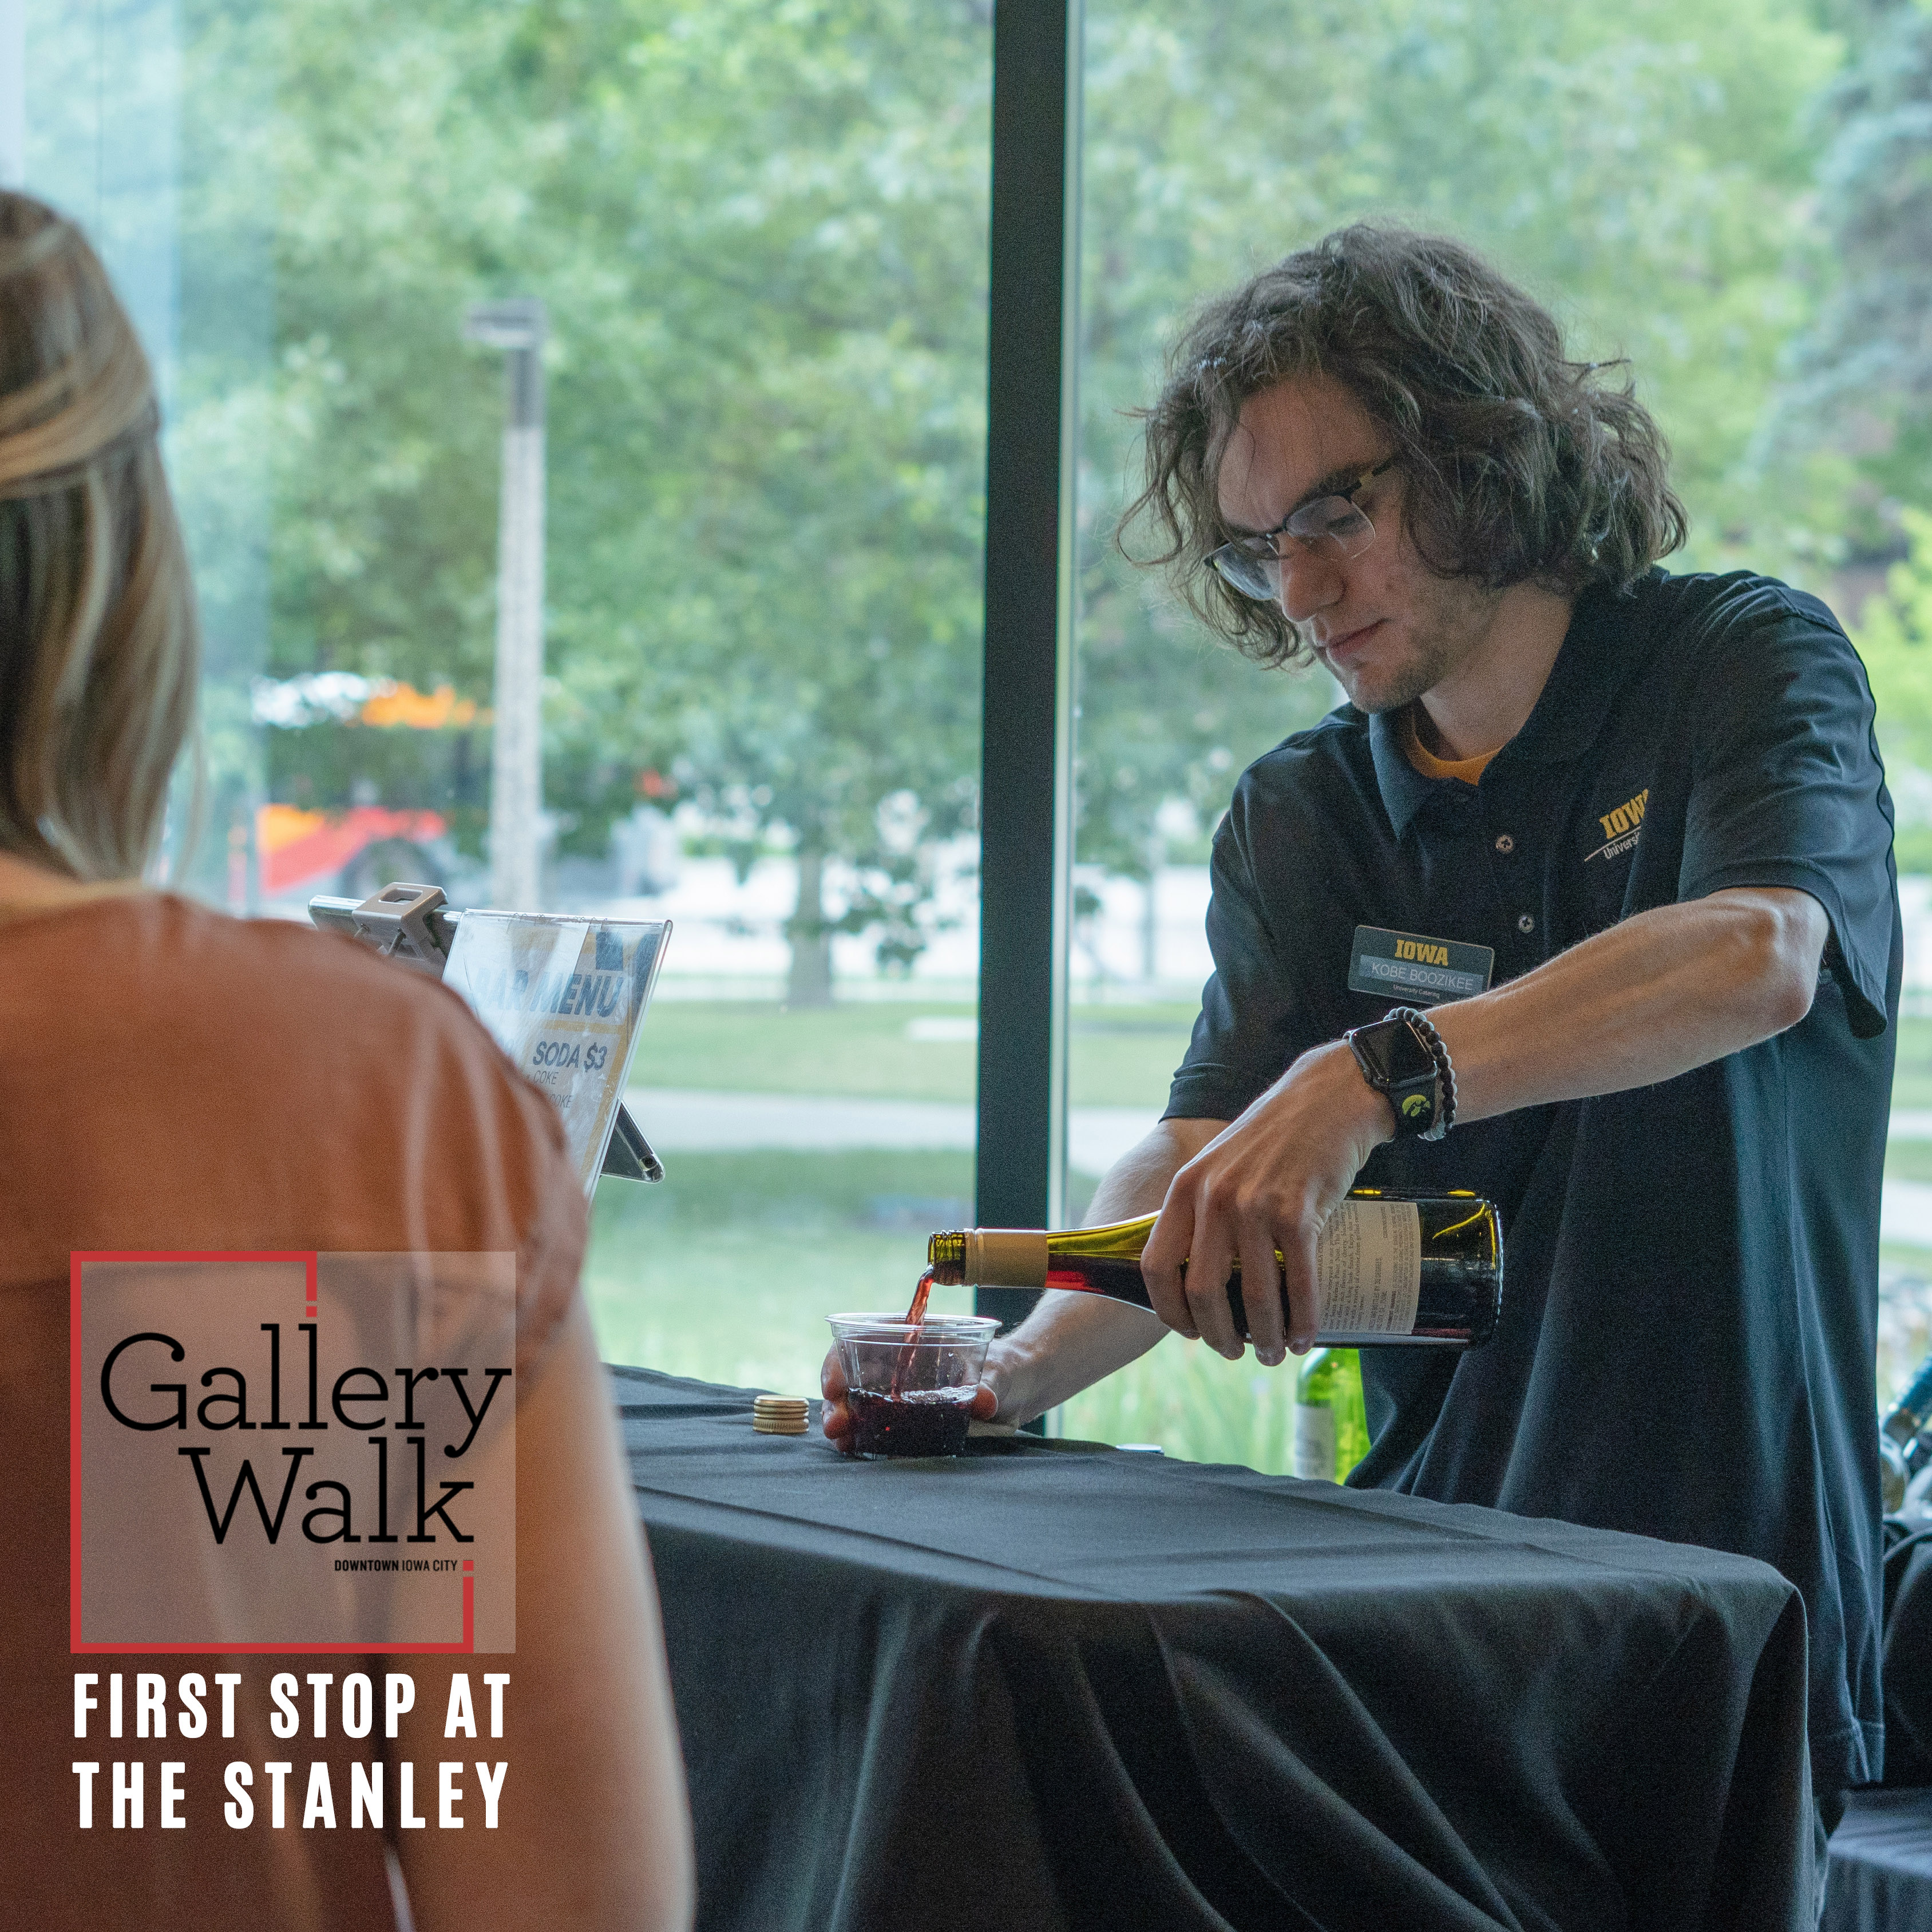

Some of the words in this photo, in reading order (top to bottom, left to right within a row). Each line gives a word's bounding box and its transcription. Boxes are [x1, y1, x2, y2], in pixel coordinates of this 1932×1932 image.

[1599, 789, 1649, 839] IOW
[1604, 832, 1640, 859] Univers
[1395, 939, 1448, 966] IOWA
[1372, 961, 1406, 980] KOBE
[476, 968, 529, 1011] BAR
[530, 972, 624, 1018] MENU
[533, 1041, 580, 1069] SODA
[584, 1042, 608, 1073] $3
[533, 1070, 560, 1086] COKE
